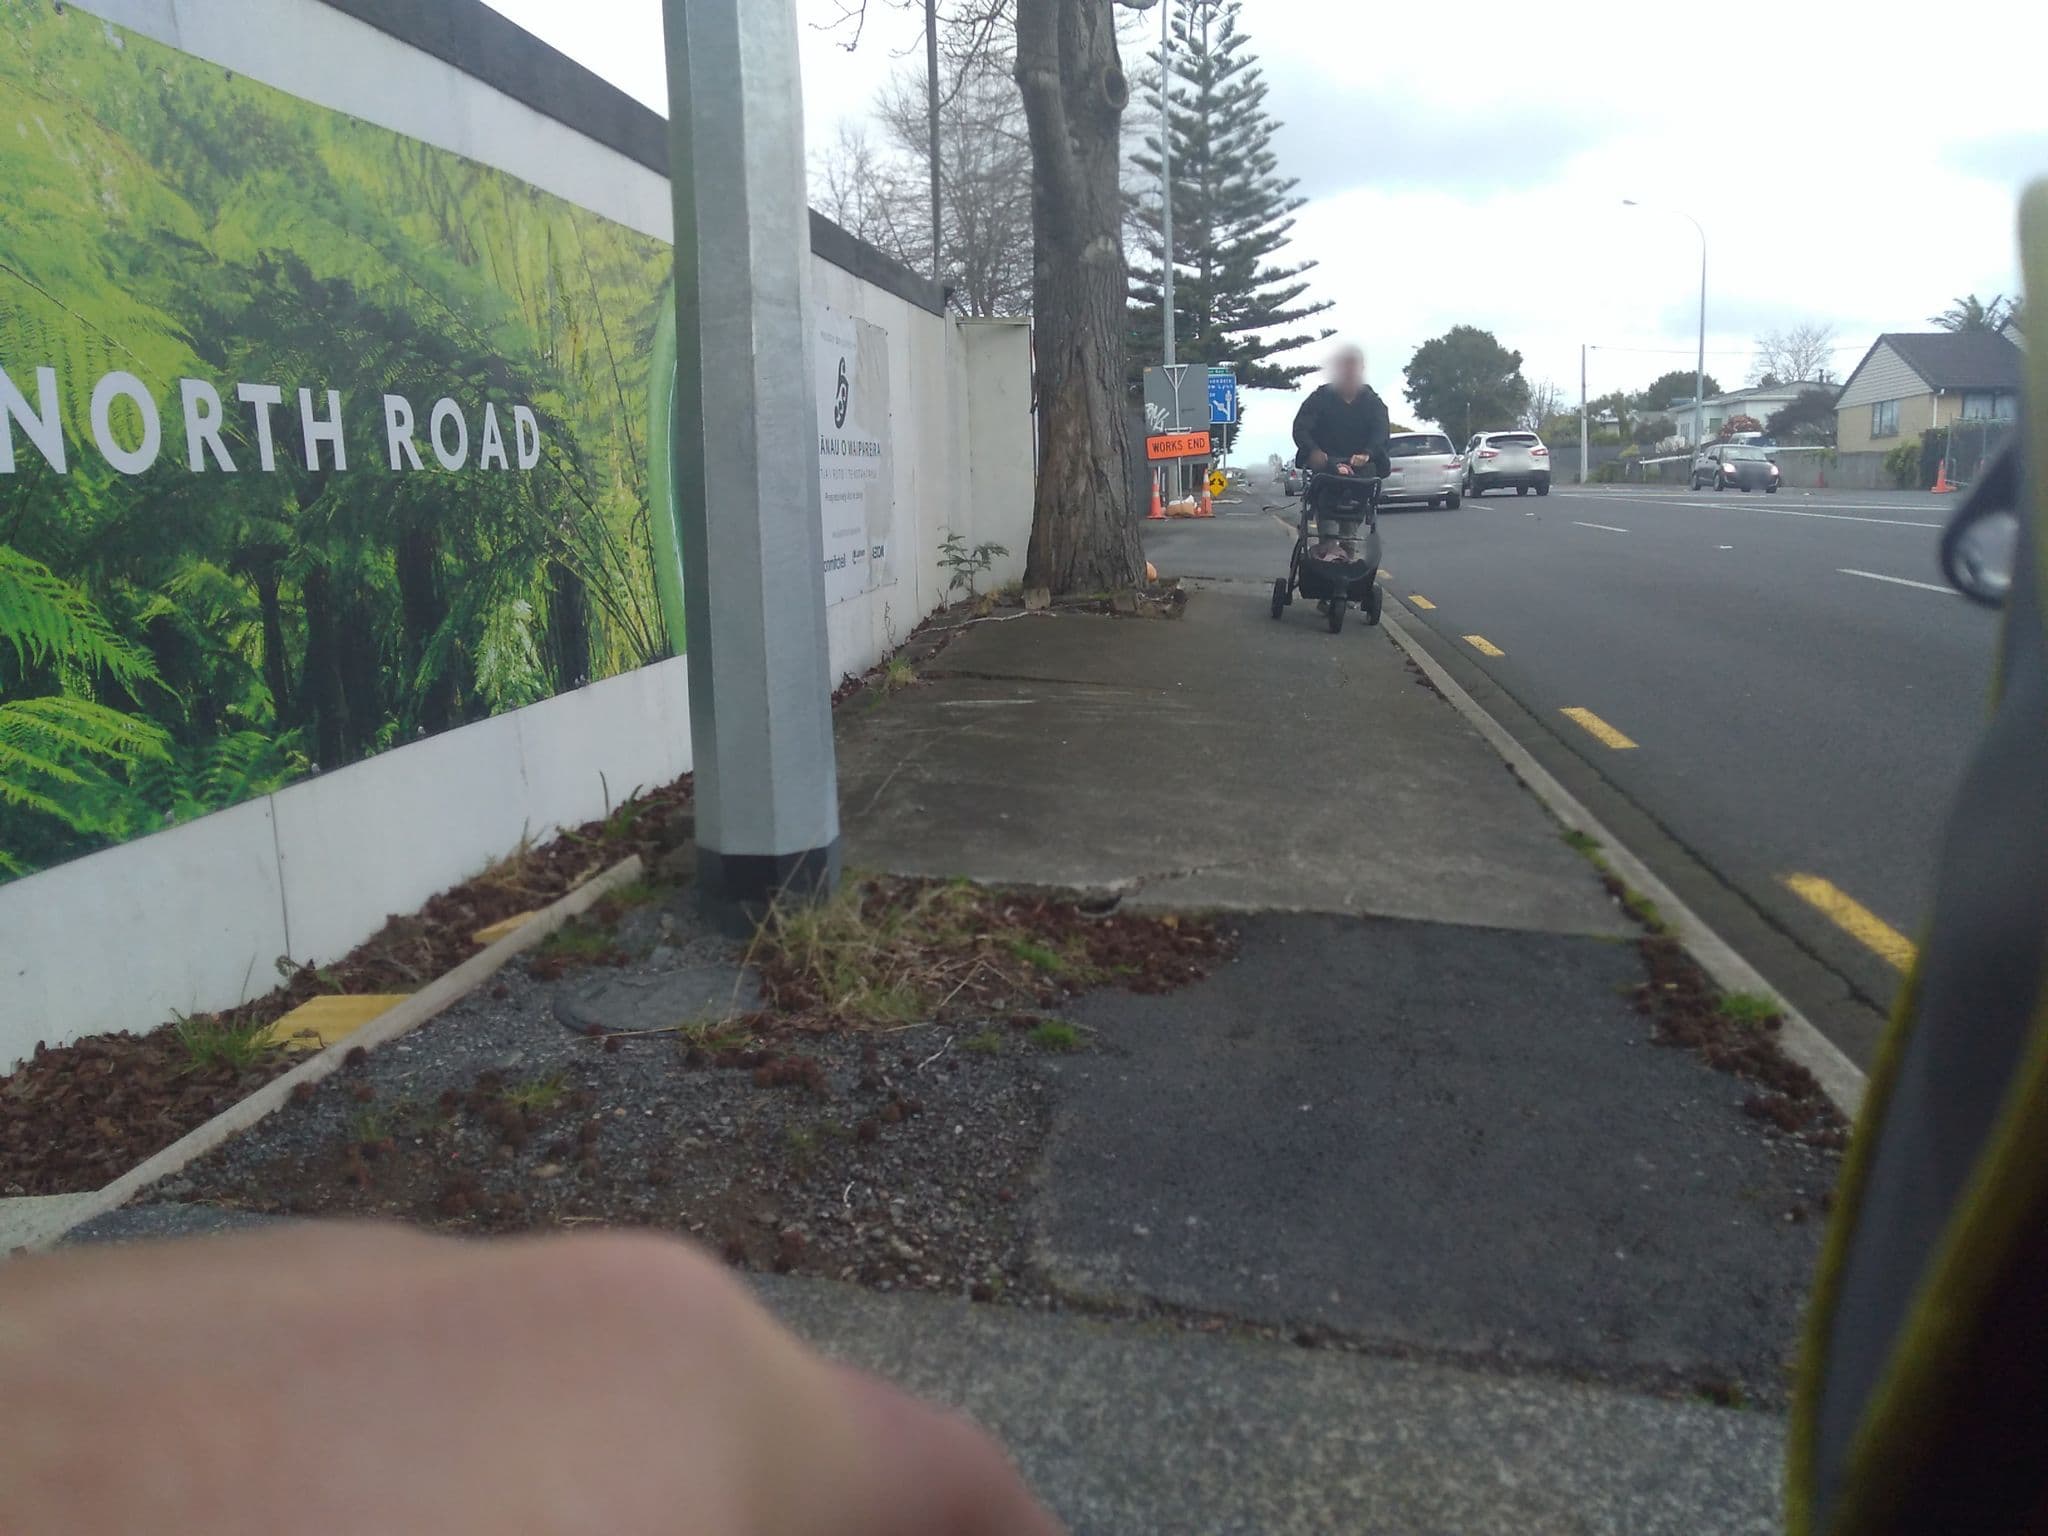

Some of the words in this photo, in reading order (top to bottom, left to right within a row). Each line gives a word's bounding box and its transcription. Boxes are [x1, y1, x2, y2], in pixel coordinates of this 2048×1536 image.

[0, 365, 347, 475] NORTH
[383, 393, 541, 472] ROAD
[819, 434, 840, 456] ĀNAU
[1151, 440, 1183, 454] WORKS
[1187, 437, 1206, 450] END
